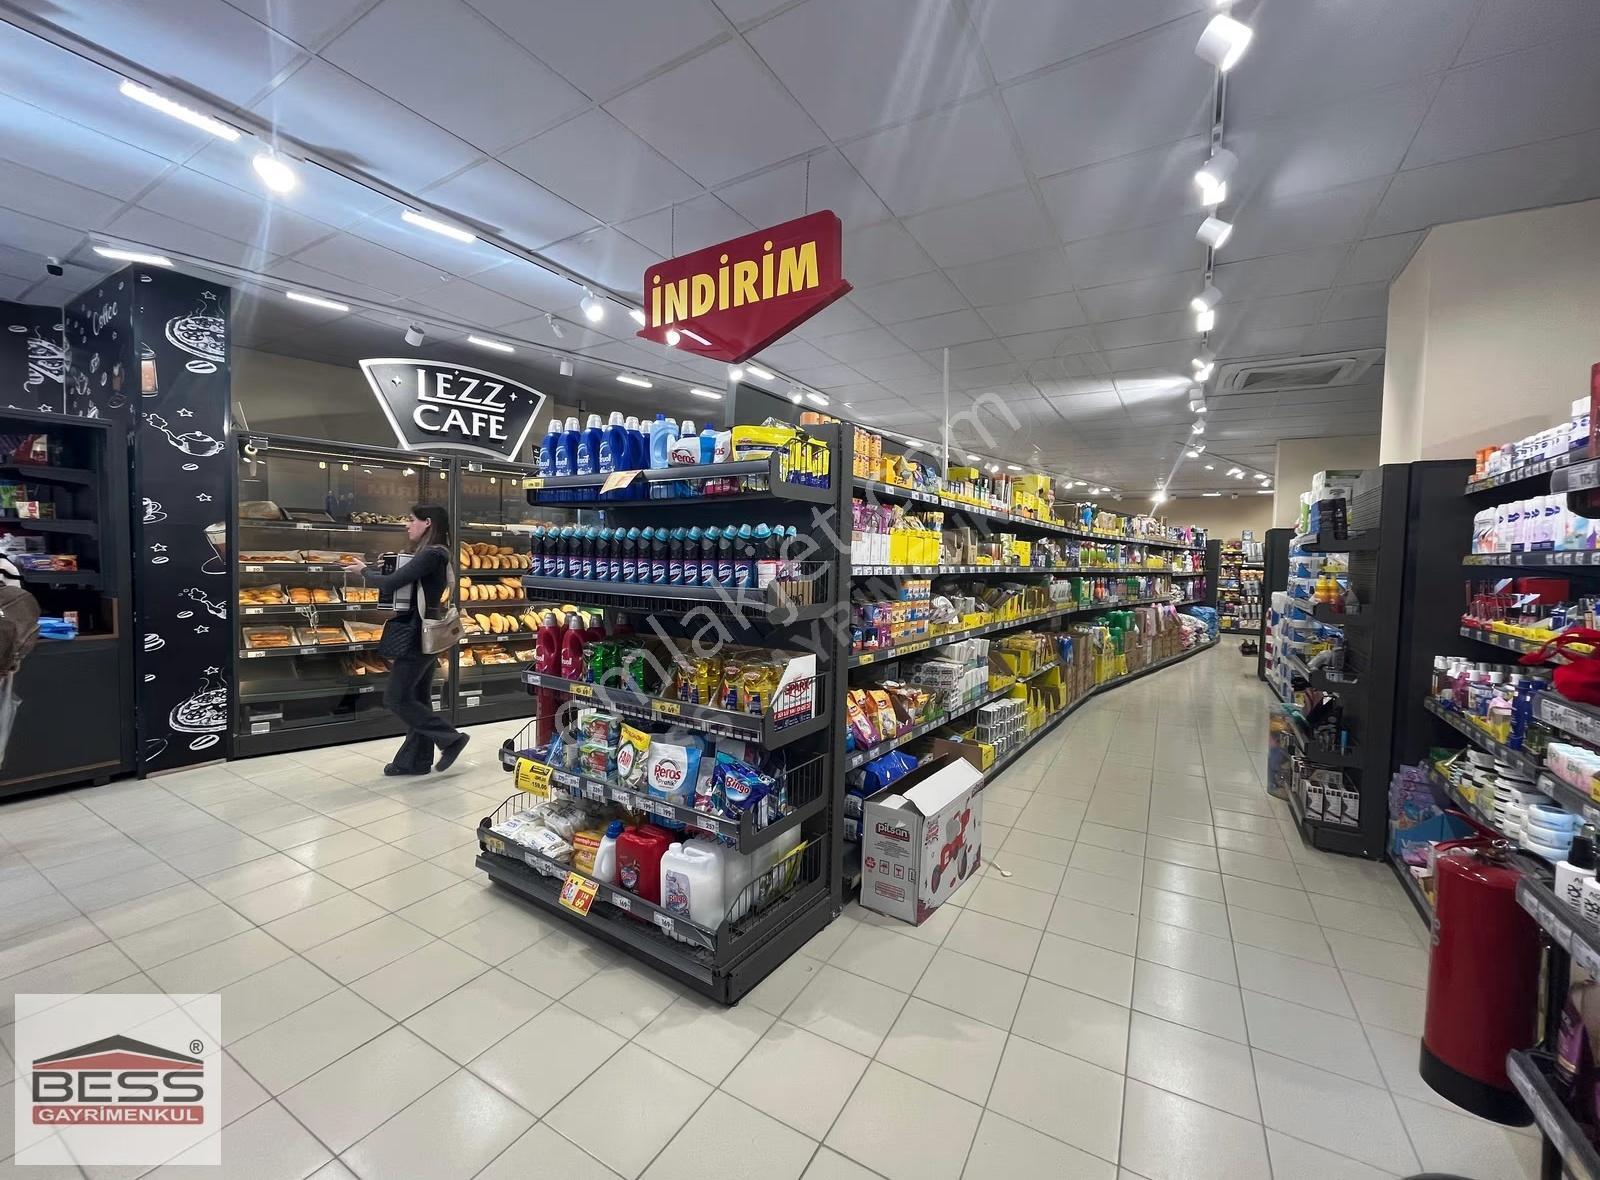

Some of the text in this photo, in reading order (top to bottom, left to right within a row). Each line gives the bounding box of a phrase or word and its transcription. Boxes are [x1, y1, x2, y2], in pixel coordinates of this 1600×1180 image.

[652, 240, 819, 328] İNDİRİM
[93, 302, 118, 336] Coffee
[413, 404, 508, 441] CAFE
[671, 451, 696, 464] Peros
[655, 764, 682, 781] Peros
[725, 775, 751, 794] Bingo
